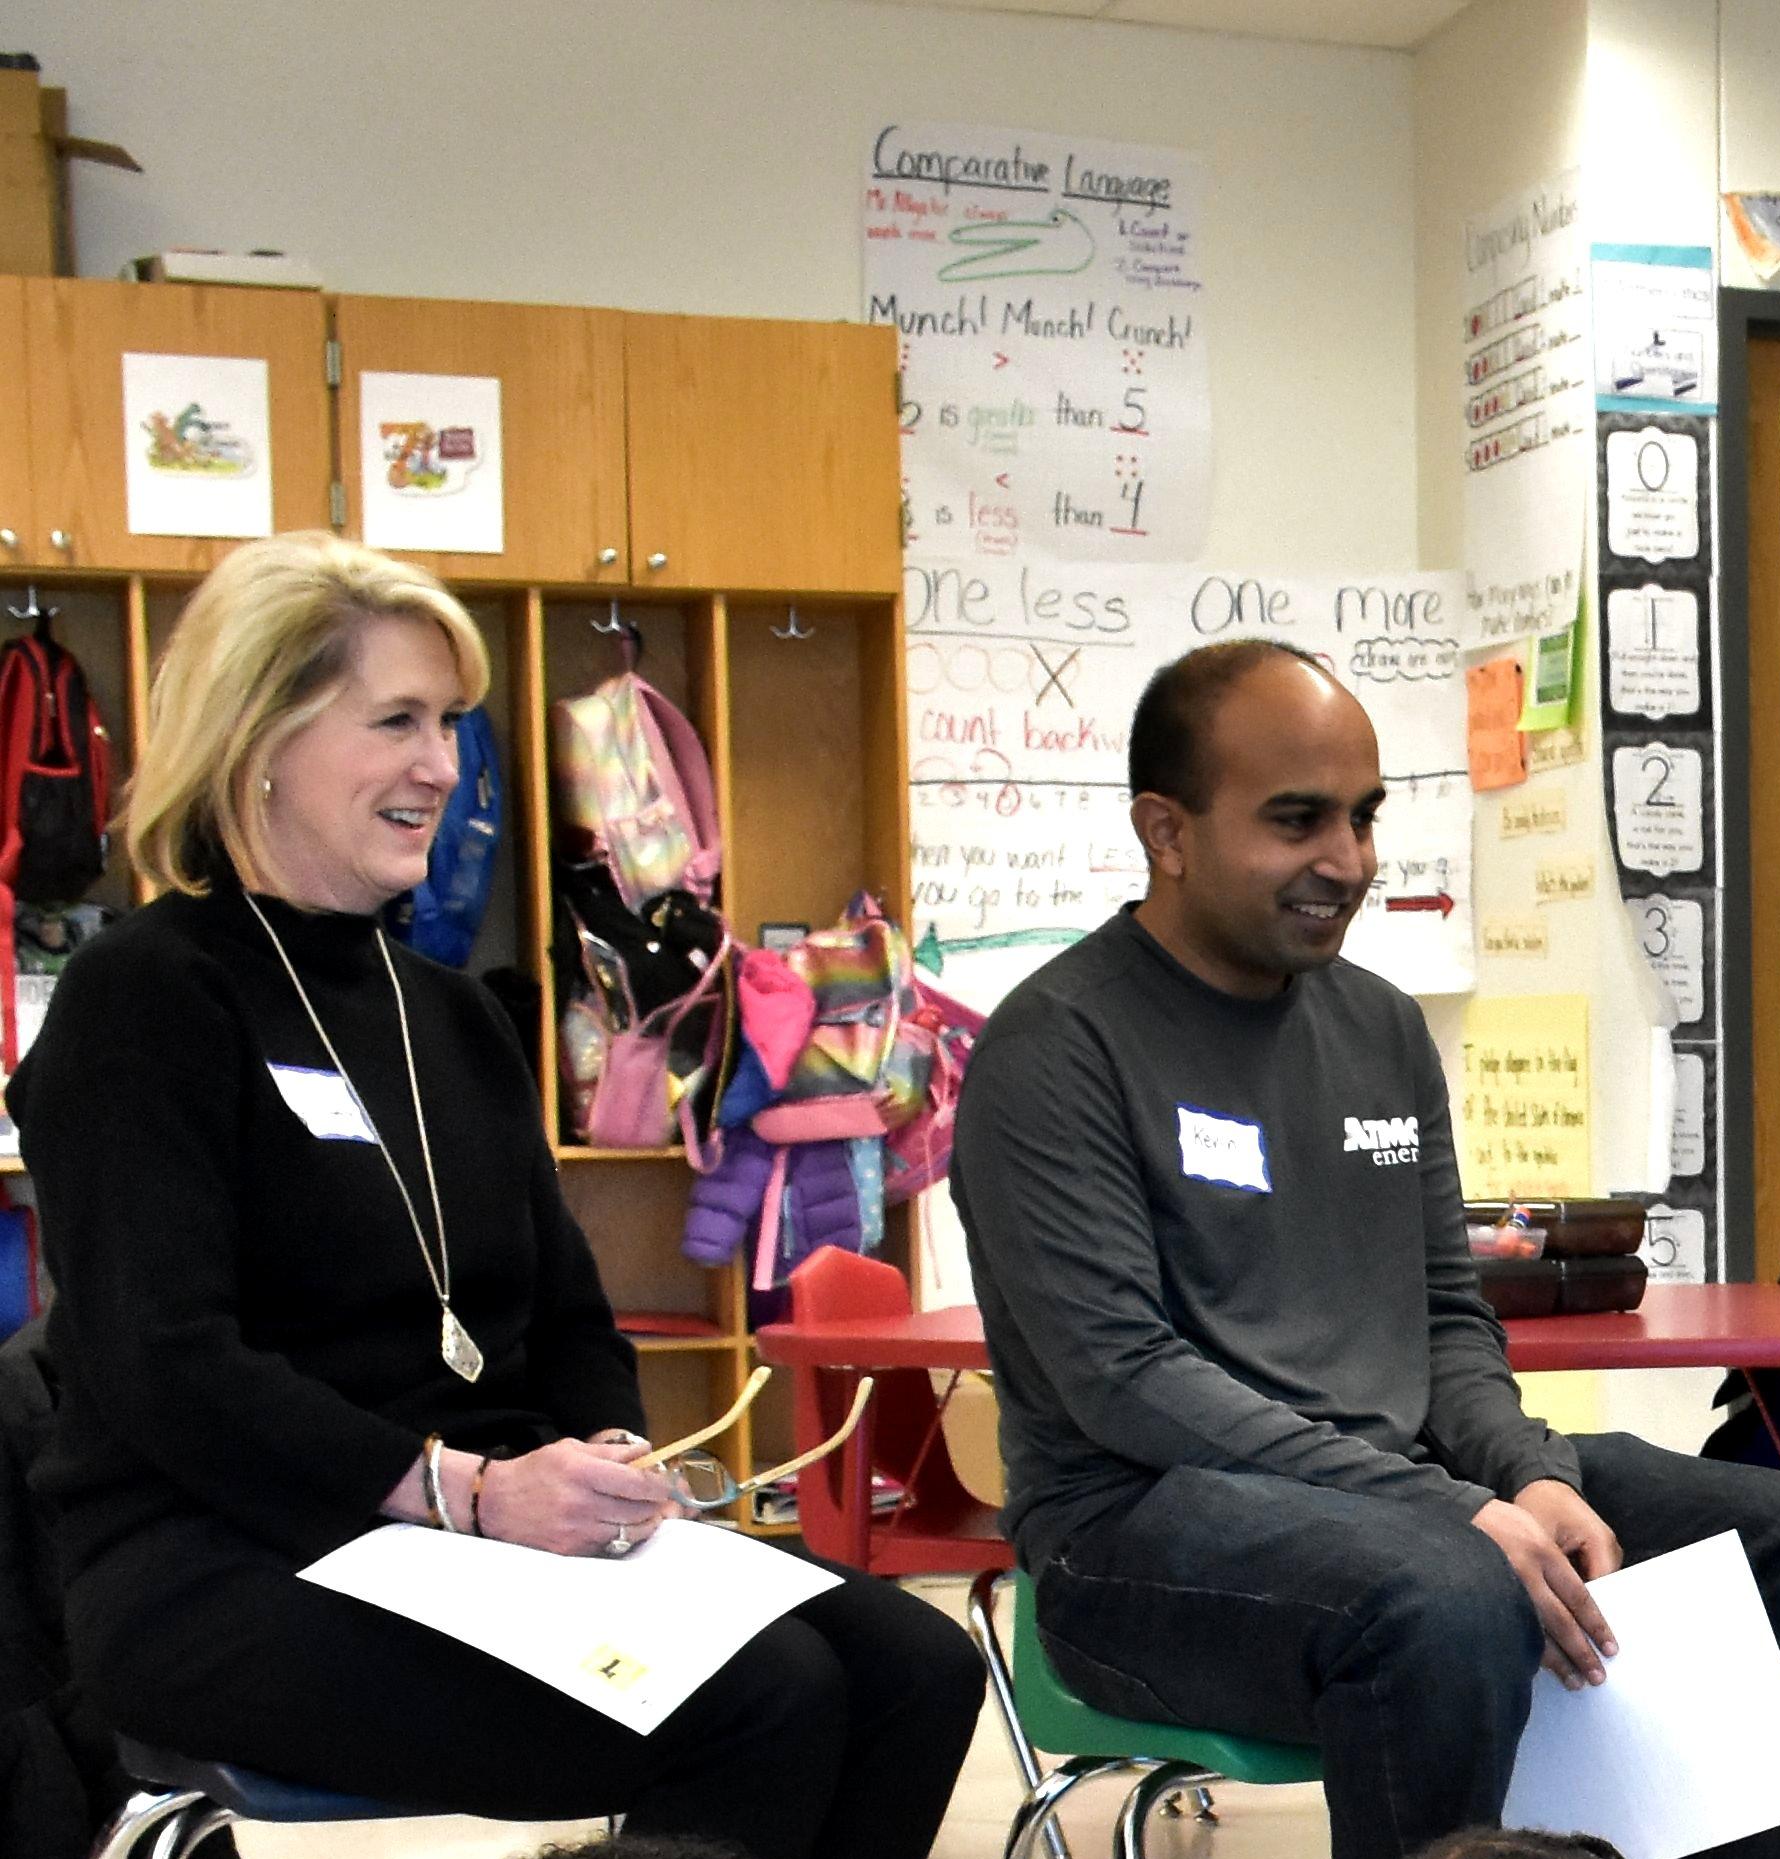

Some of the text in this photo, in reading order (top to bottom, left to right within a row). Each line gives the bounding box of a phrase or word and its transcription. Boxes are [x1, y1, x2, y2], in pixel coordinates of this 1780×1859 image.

[873, 125, 1049, 185] Comparative
[868, 295, 1191, 350] Munch! Munch! Crunch!
[1056, 391, 1103, 428] than
[1118, 387, 1148, 431] 5
[1638, 440, 1669, 492] 0
[968, 490, 1019, 528] less
[1053, 491, 1103, 527] than
[1120, 480, 1145, 528] 4
[1020, 567, 1131, 632] less
[1190, 575, 1296, 635] One
[1336, 585, 1445, 632] more
[920, 707, 1000, 747] count
[1642, 756, 1676, 806] 2
[961, 845, 995, 877] you
[969, 886, 1000, 930] go
[1016, 877, 1040, 906] to
[1644, 906, 1669, 958] 3
[1647, 1215, 1677, 1267] 5
